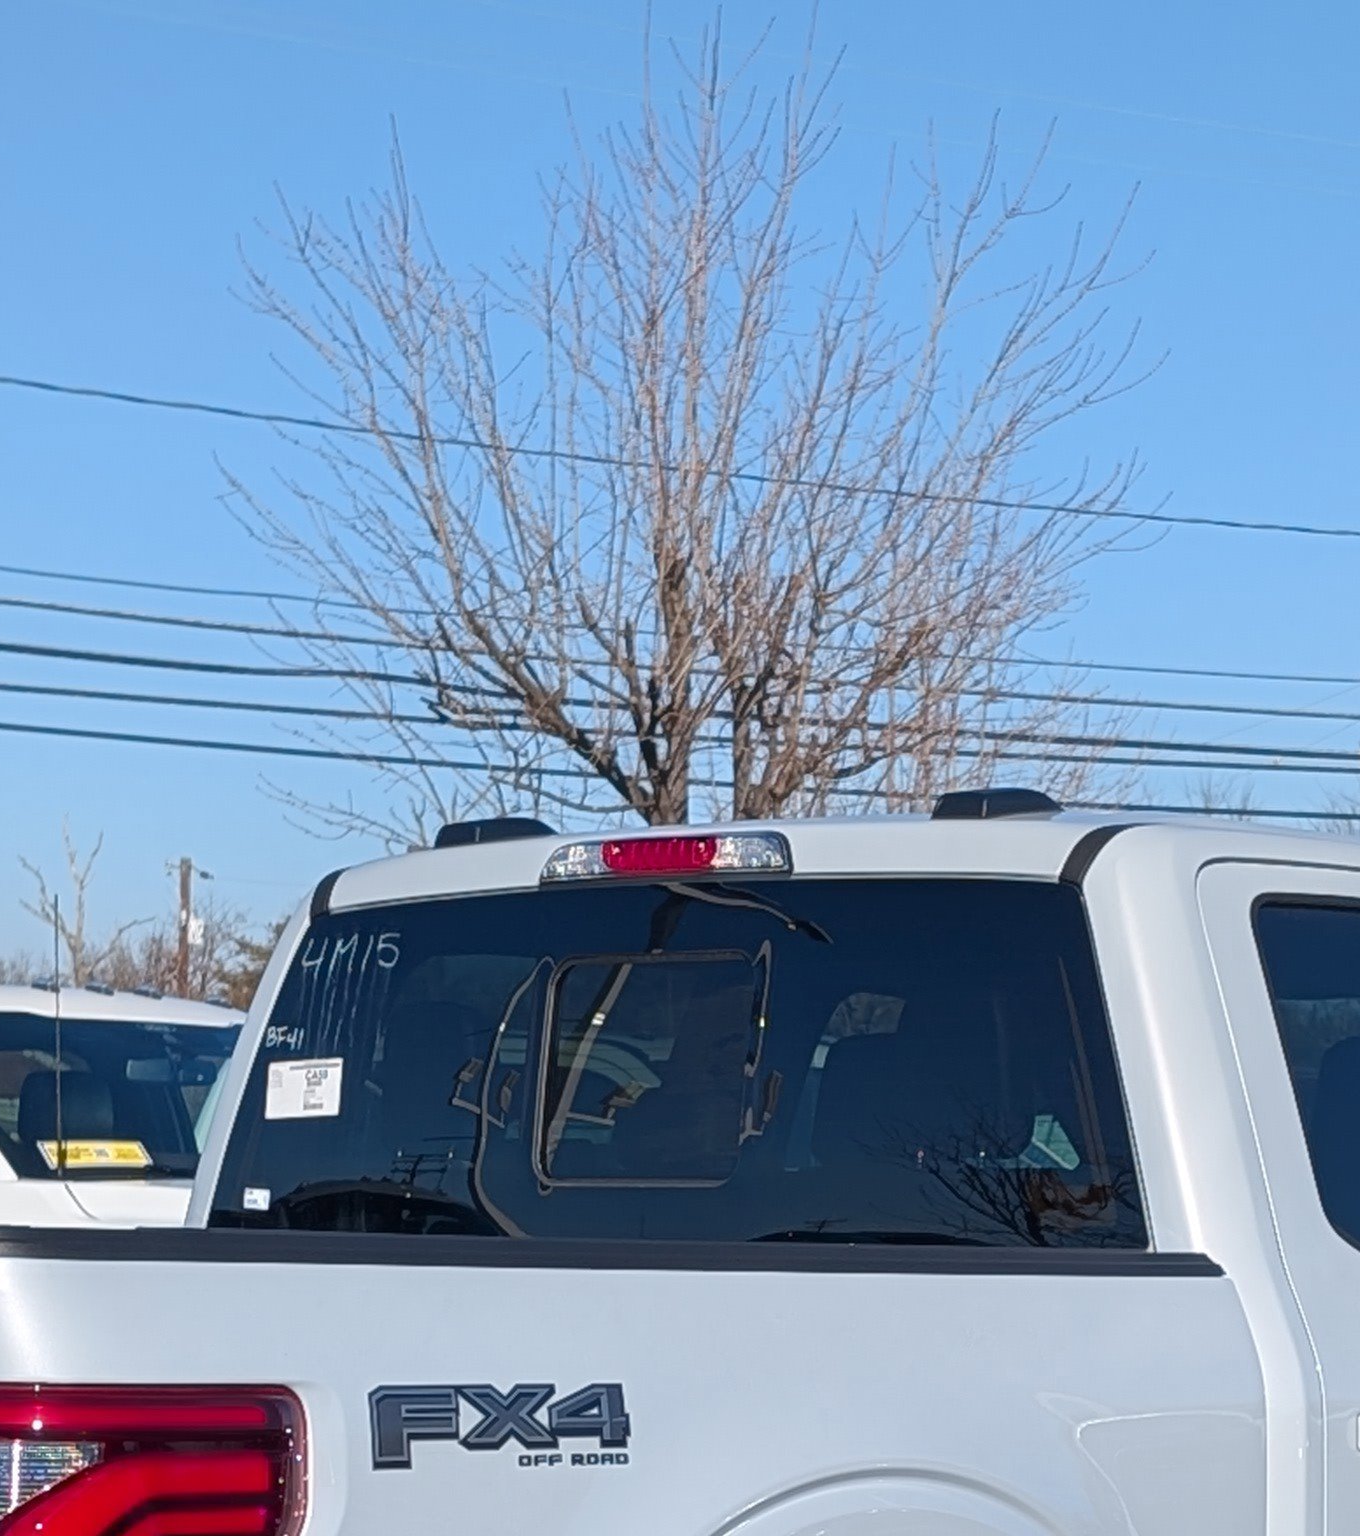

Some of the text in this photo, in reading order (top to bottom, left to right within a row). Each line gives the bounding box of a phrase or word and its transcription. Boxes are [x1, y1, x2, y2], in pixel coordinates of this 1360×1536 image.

[368, 1383, 631, 1471] FX4
[518, 1452, 630, 1468] OFF ROAD
